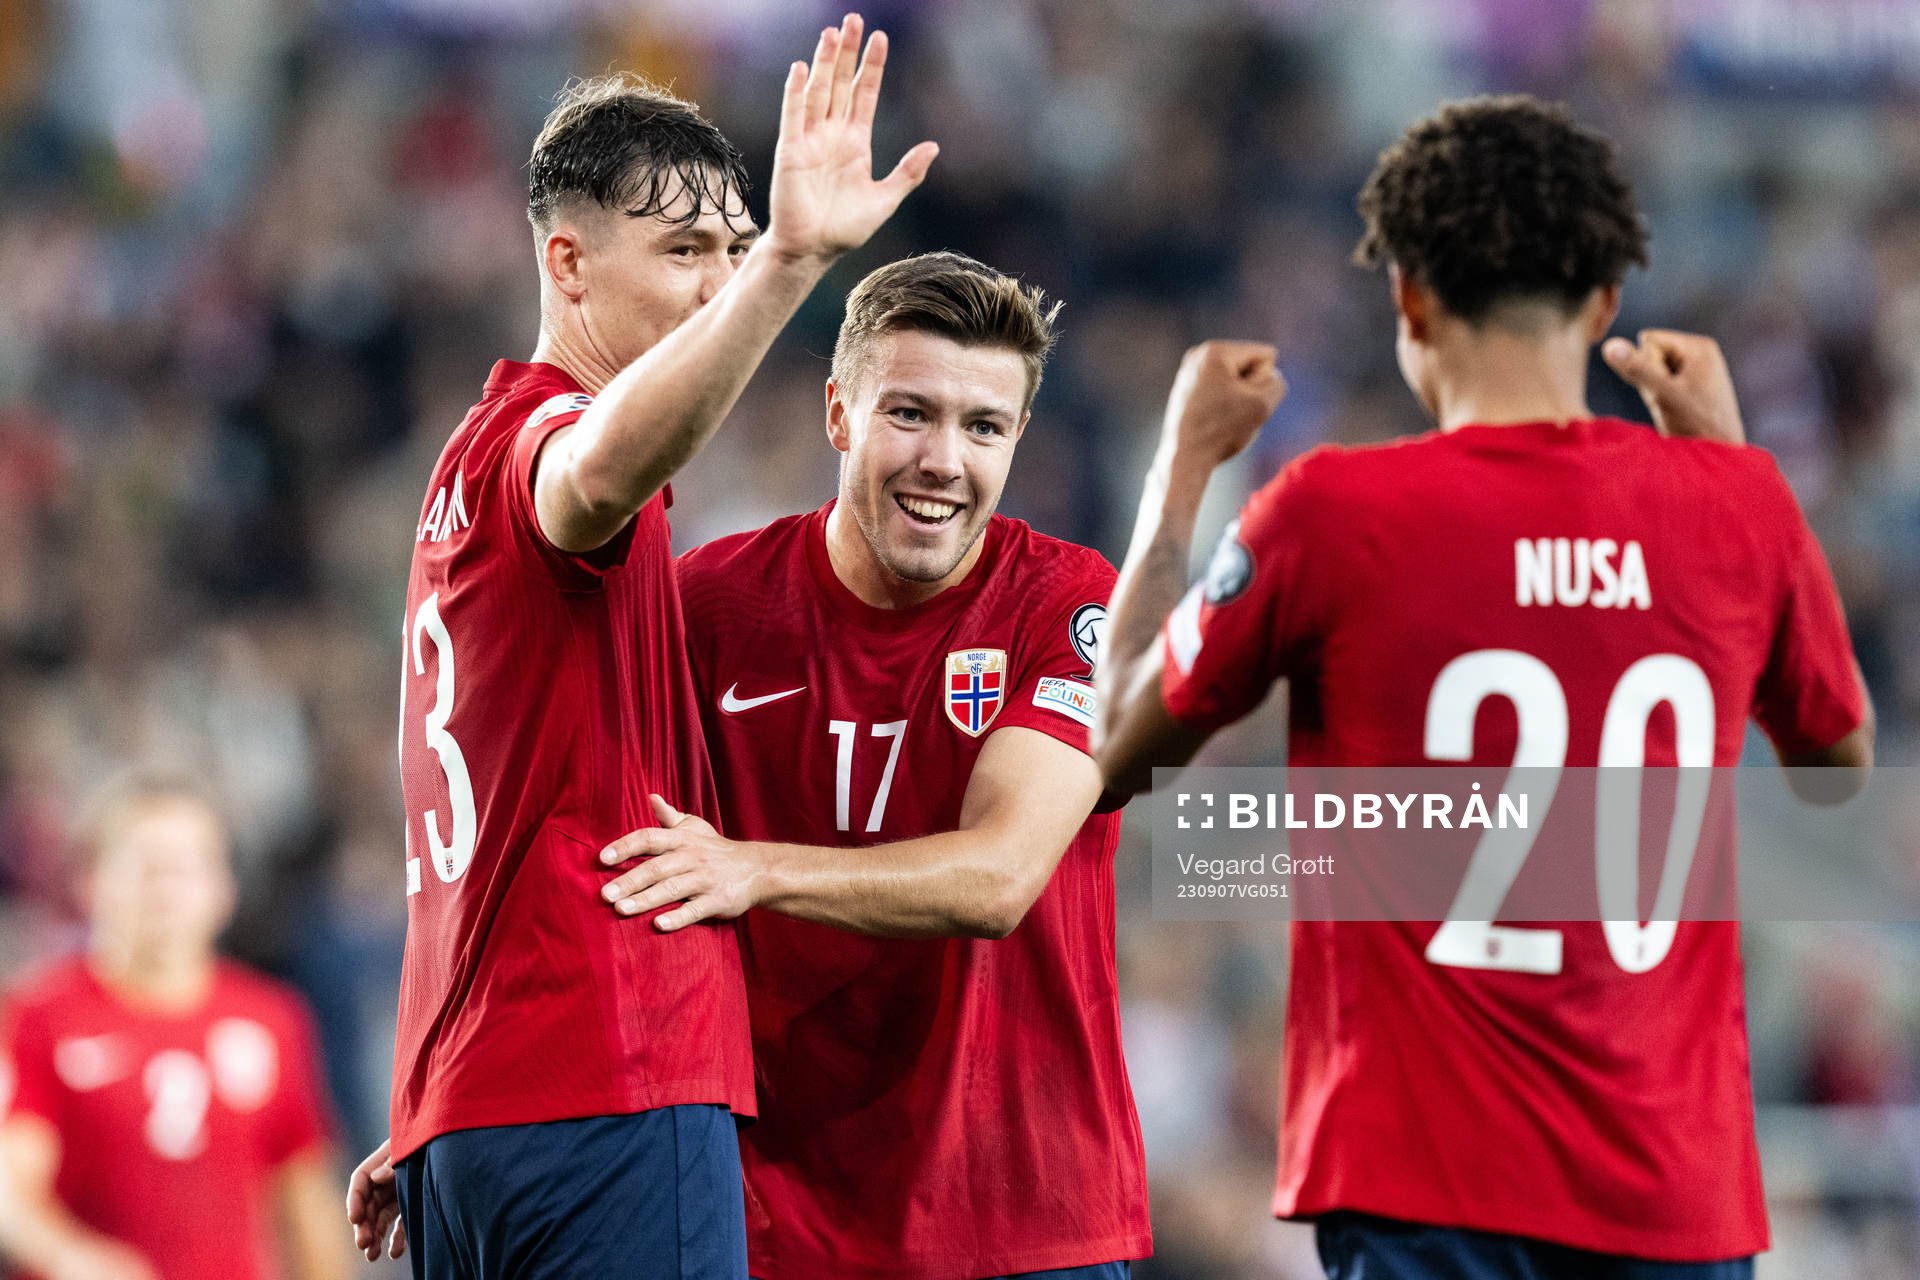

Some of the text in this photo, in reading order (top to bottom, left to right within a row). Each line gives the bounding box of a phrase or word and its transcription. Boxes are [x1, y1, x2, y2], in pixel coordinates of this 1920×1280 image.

[1515, 537, 1652, 610] NUSA
[967, 652, 987, 661] NORGE
[1041, 678, 1066, 688] UEFA
[399, 592, 477, 897] 3
[828, 719, 909, 832] 17
[1424, 648, 1716, 975] 20
